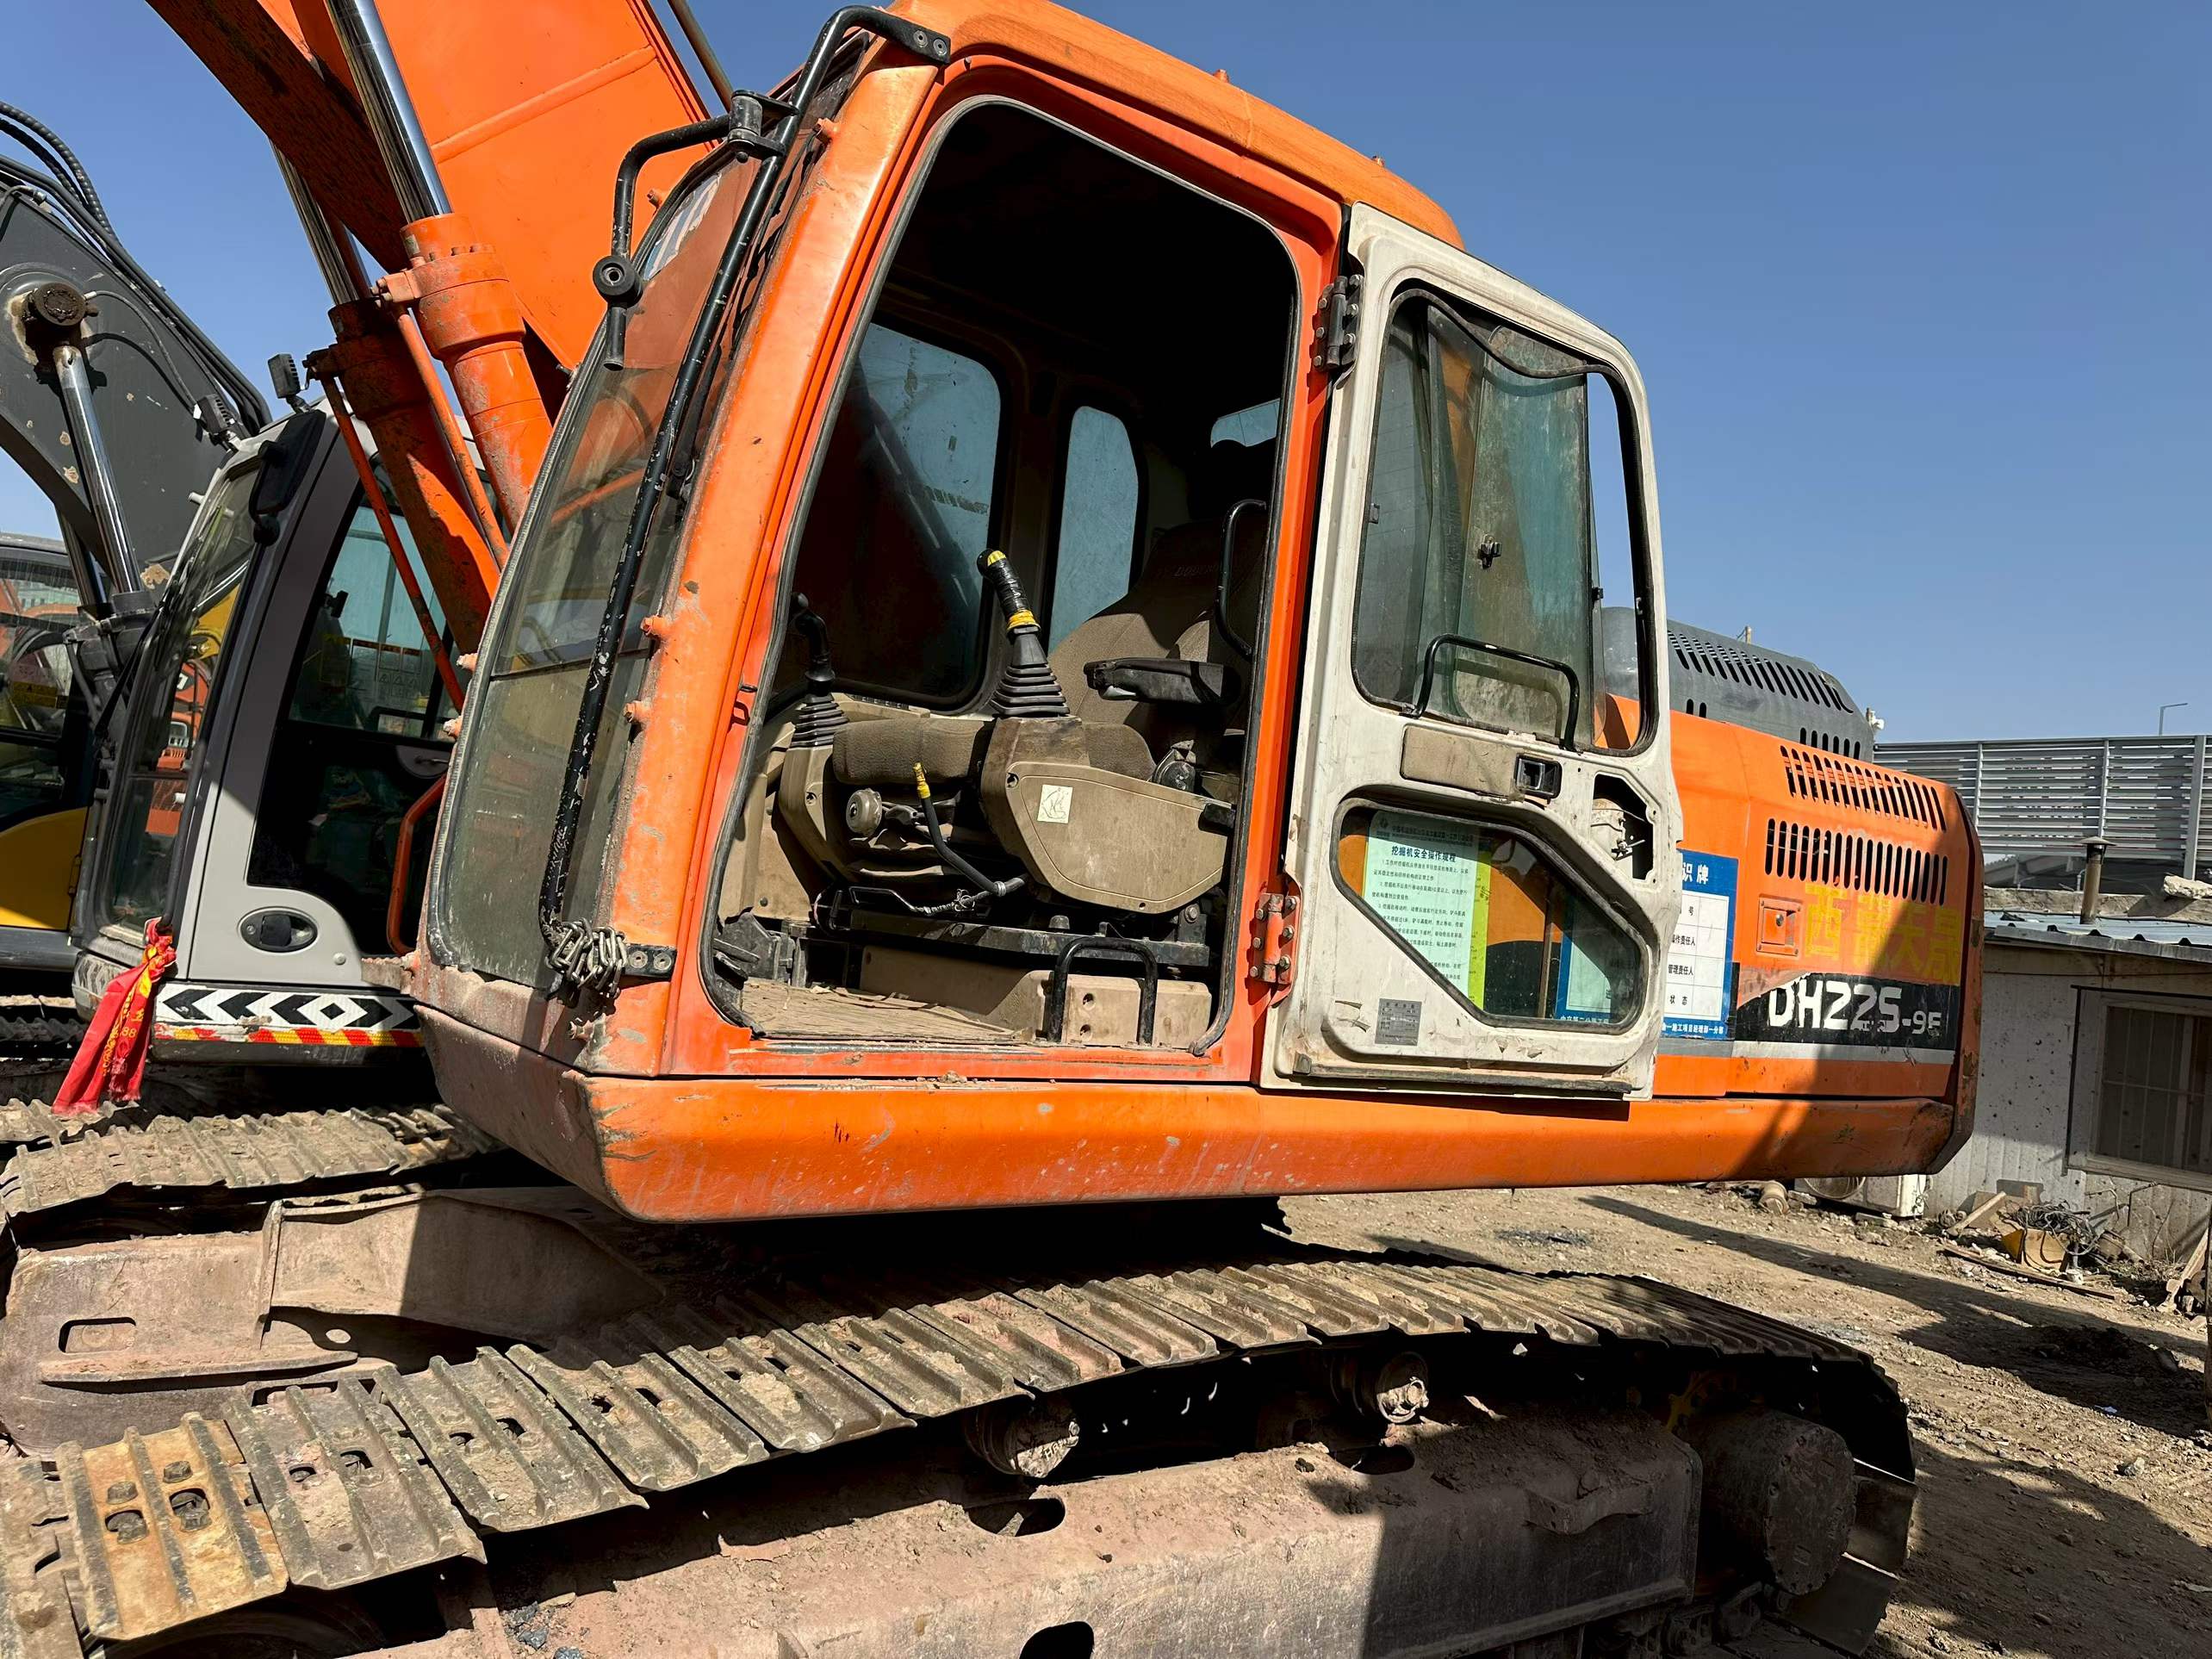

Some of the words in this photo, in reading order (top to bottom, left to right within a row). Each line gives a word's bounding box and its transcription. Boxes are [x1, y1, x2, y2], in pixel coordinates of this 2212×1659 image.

[1391, 846, 1457, 863] 挖掘机安全操作规程
[1668, 964, 1694, 976] 管理责任人
